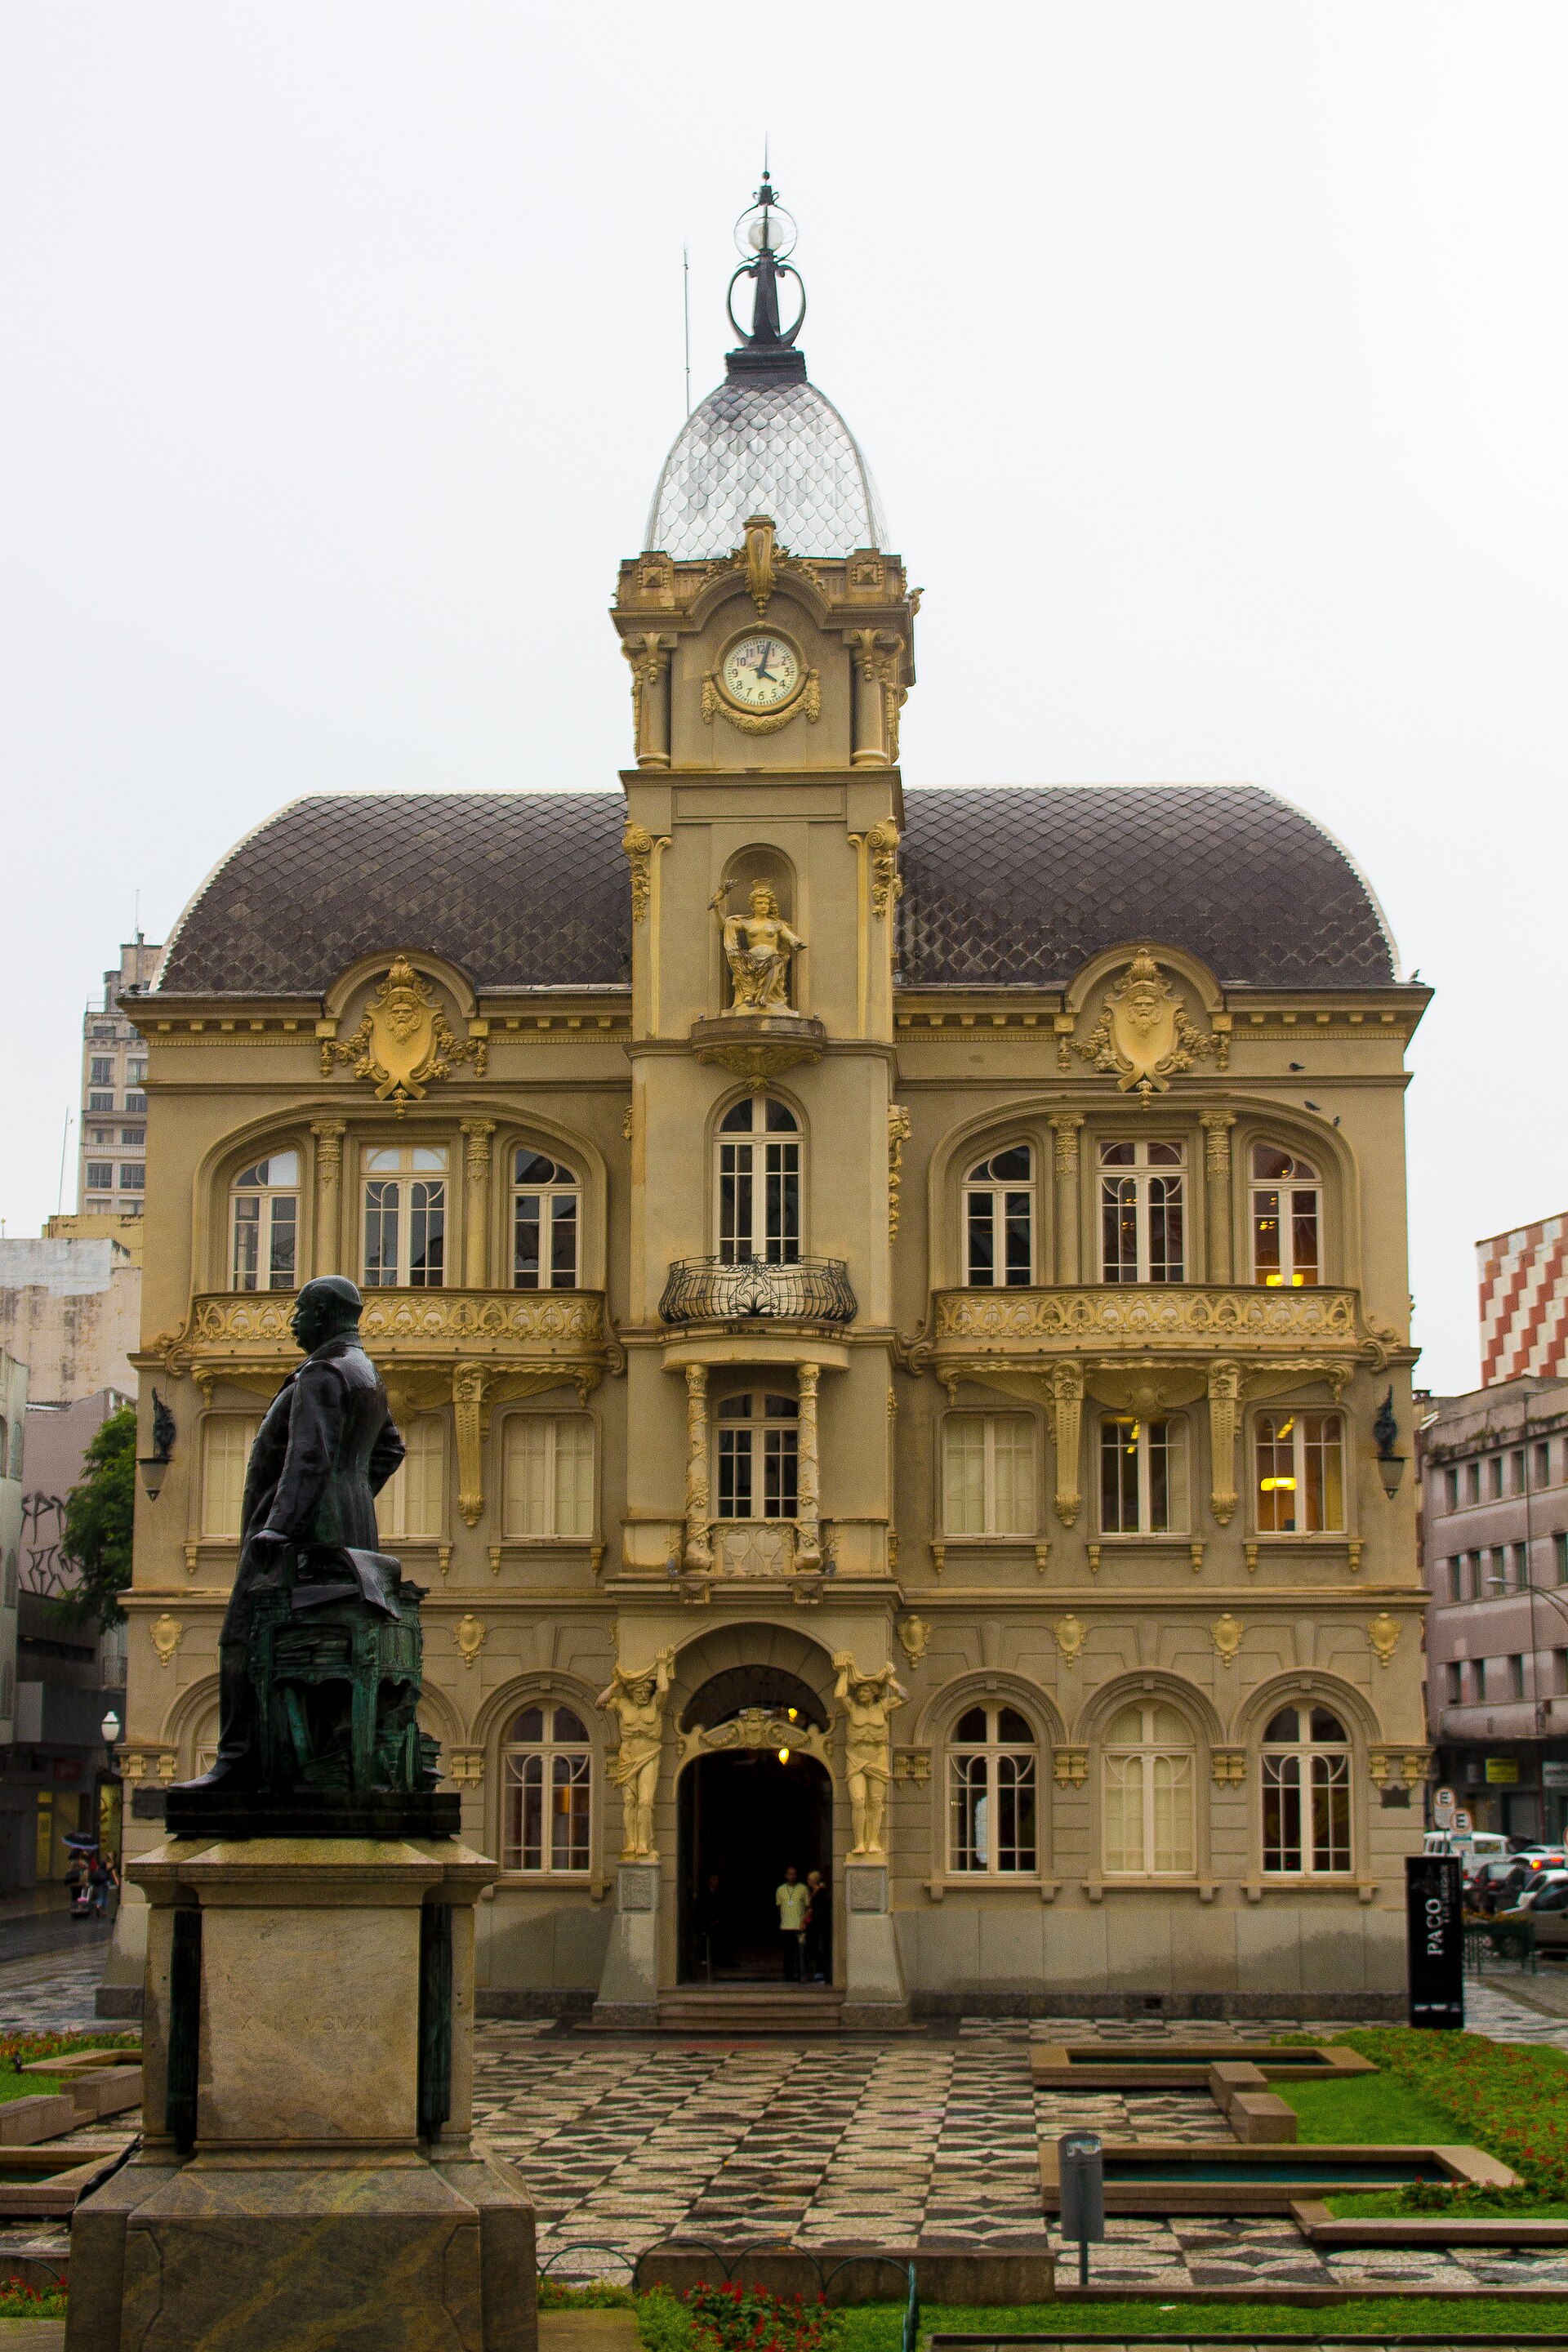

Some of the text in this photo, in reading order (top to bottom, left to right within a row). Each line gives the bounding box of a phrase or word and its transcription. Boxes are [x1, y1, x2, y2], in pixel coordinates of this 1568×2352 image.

[746, 648, 754, 658] 11
[756, 645, 765, 654] 12
[771, 648, 776, 657] 1
[736, 657, 746, 667] 10
[781, 656, 786, 666] 2
[732, 668, 738, 678] 9
[784, 667, 791, 676] 3
[736, 680, 743, 690] 8
[779, 679, 786, 688] 4
[746, 688, 753, 697] 7
[758, 691, 764, 701] 6
[771, 688, 777, 697] 5
[1456, 1812, 1466, 1829] E
[1425, 1897, 1448, 1956] PAÇO
